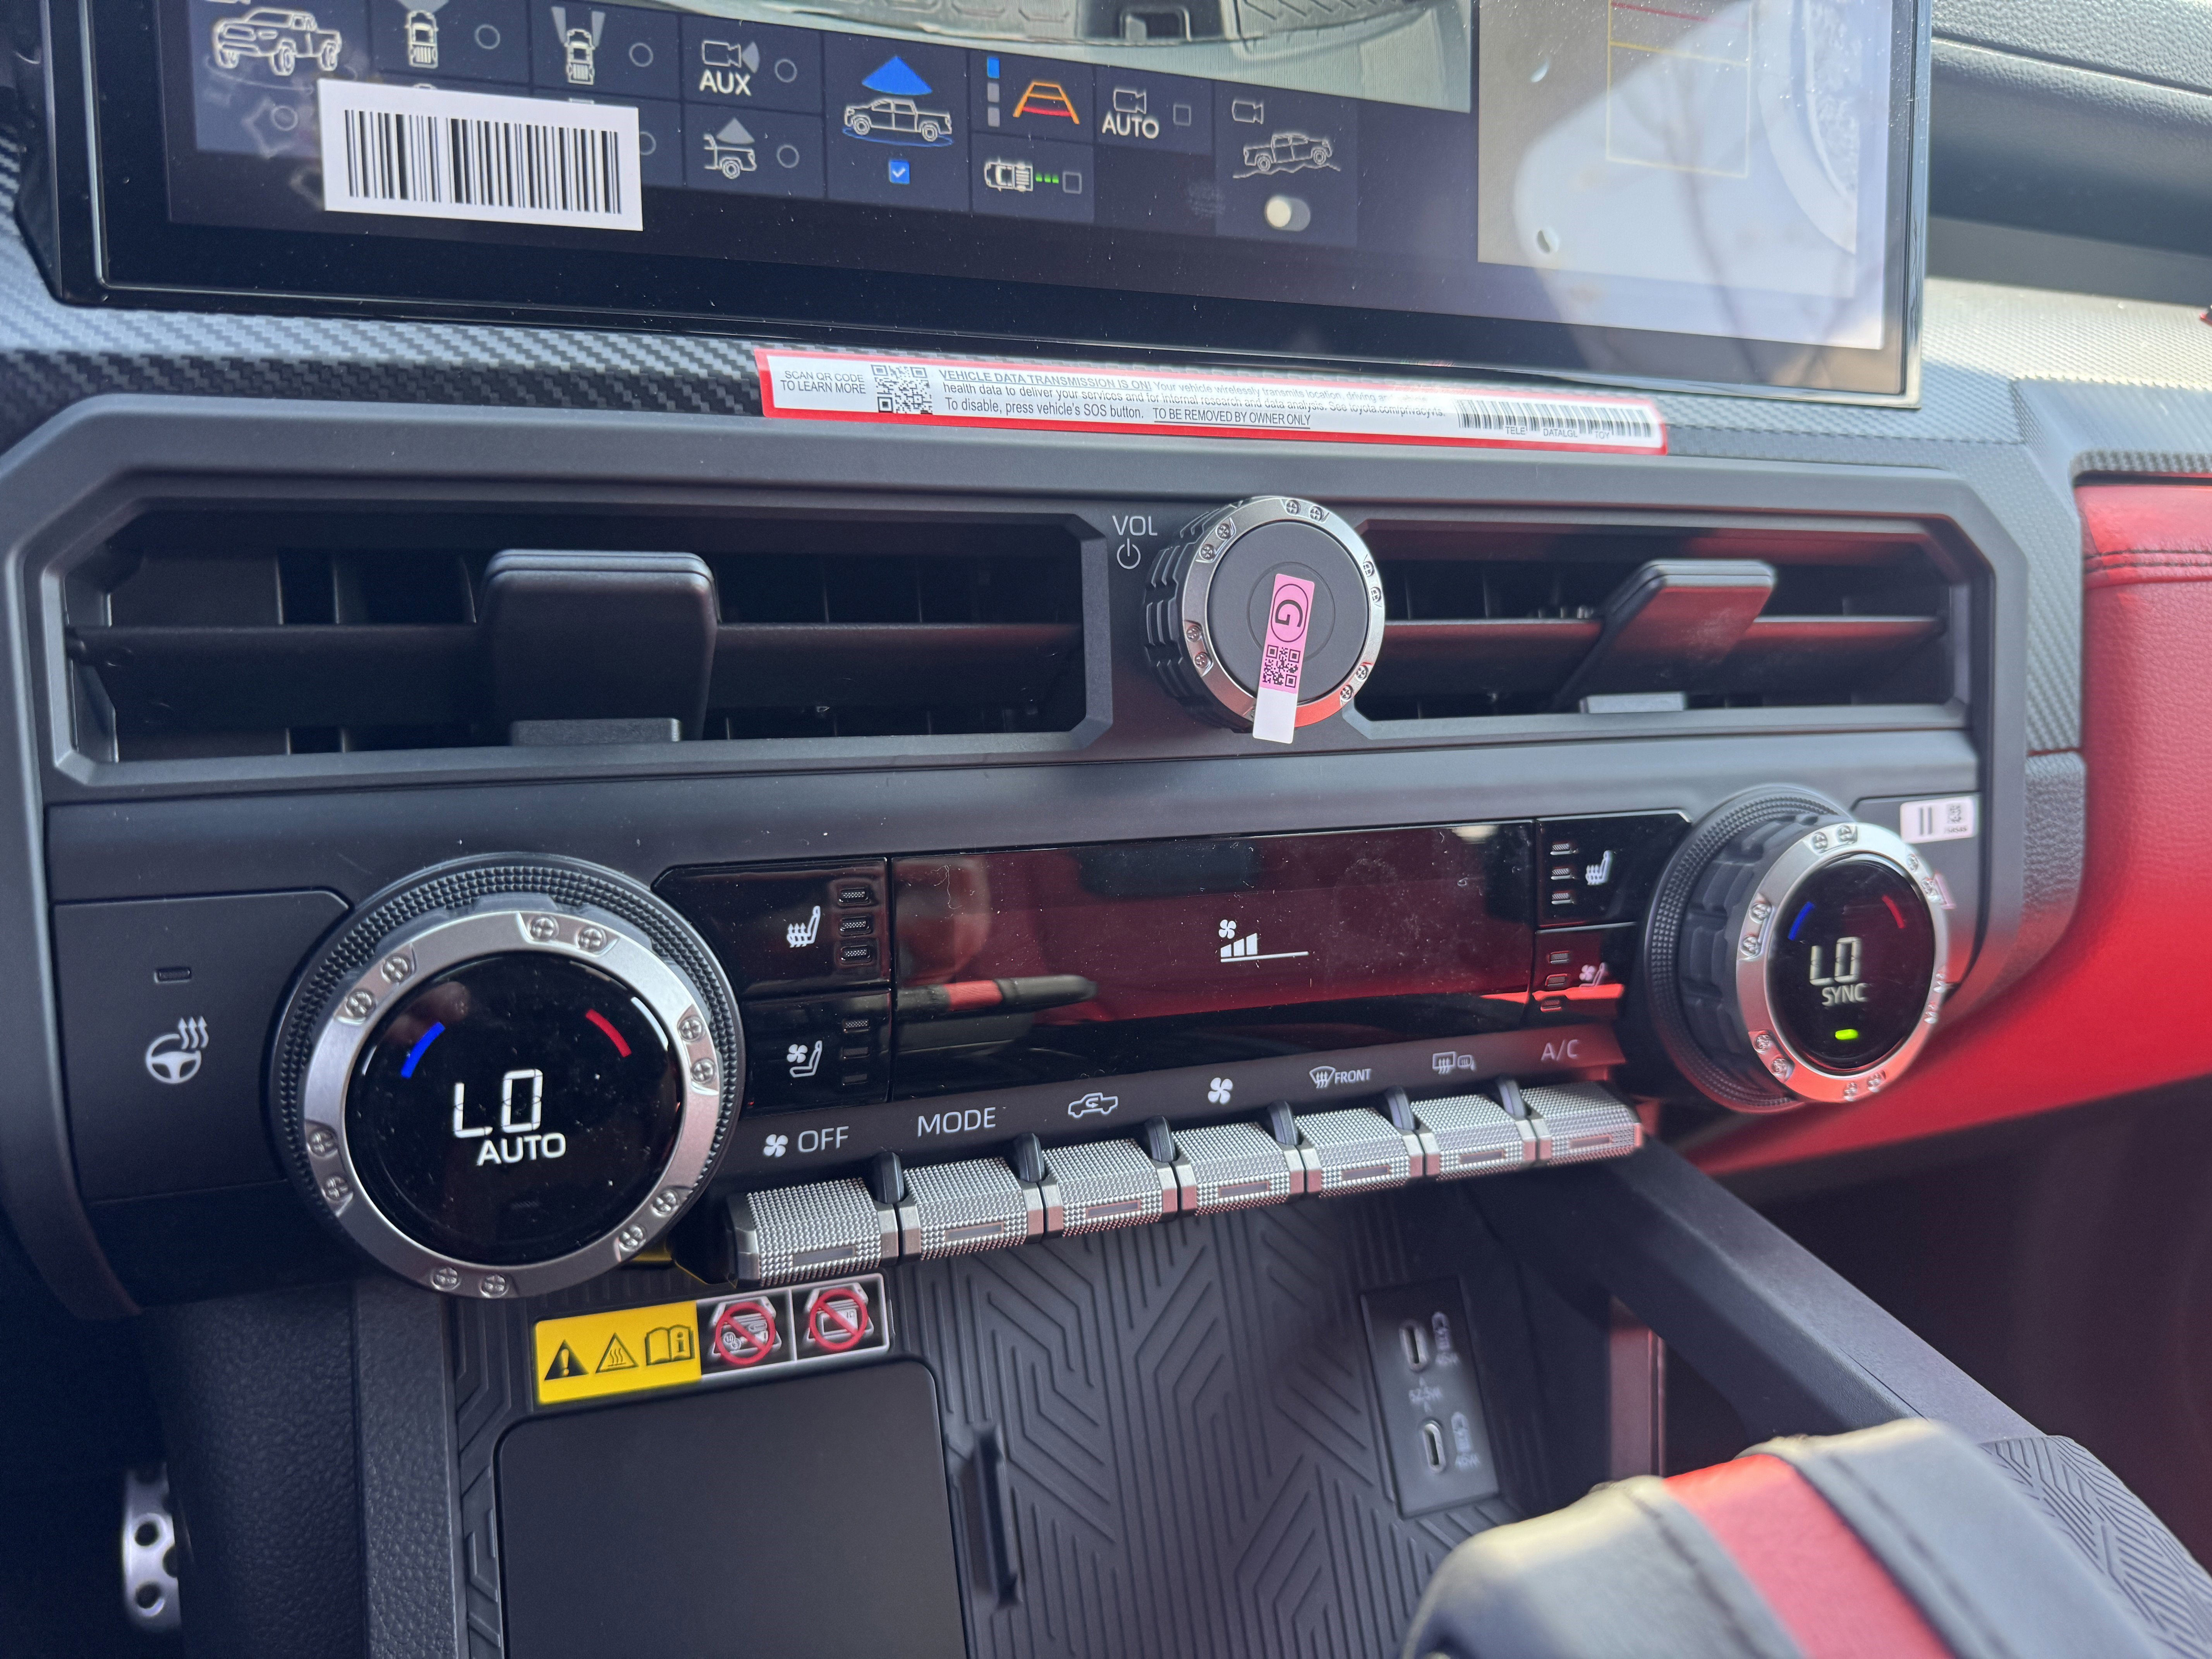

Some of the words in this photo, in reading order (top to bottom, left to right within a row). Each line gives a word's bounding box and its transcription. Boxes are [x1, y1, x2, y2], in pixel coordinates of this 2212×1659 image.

[699, 69, 751, 96] AUX
[1102, 110, 1159, 139] AUTO
[780, 380, 795, 391] TO
[798, 381, 832, 392] LEARN
[835, 383, 866, 394] MORE
[785, 371, 814, 380] SCAN
[816, 373, 832, 381] QR
[835, 373, 864, 382] CODE
[939, 370, 992, 381] VEHICLE
[994, 373, 1026, 383] DATA
[1027, 375, 1115, 388] TRANSMISSION
[1118, 380, 1128, 388] IS
[1132, 381, 1152, 390] ON!
[1153, 381, 1177, 391] Your
[1179, 384, 1212, 393] vehicle
[1214, 385, 1259, 397] wirelessly
[1262, 387, 1304, 398] transmits
[1306, 390, 1345, 400] location,
[1346, 392, 1376, 403] driving
[943, 382, 976, 394] health
[979, 384, 1002, 395] data
[1006, 386, 1015, 395] to
[1020, 386, 1053, 397] deliver
[1056, 390, 1078, 401] your
[1082, 391, 1123, 401] services
[1126, 393, 1144, 402] and
[1146, 393, 1159, 402] for
[1162, 393, 1198, 405] internal
[1201, 397, 1242, 407] research
[1245, 398, 1262, 407] and
[1265, 399, 1285, 409] data
[1288, 400, 1327, 412] analysis.
[1329, 402, 1347, 411] See
[945, 397, 958, 410] To
[962, 398, 1001, 414] disable,
[1006, 403, 1033, 416] press
[1037, 402, 1080, 416] vehicle's
[1084, 404, 1106, 416] SOS
[1111, 405, 1143, 419] button.
[1152, 408, 1166, 419] TO
[1169, 409, 1182, 419] BE
[1185, 409, 1232, 422] REMOVED
[1235, 412, 1247, 422] BY
[1249, 412, 1285, 424] OWNER
[1287, 414, 1310, 426] ONLY
[1505, 426, 1525, 435] TELE
[1112, 515, 1158, 536] VOL
[1275, 599, 1303, 627] G
[1822, 982, 1869, 1007] SYNC
[1541, 1039, 1580, 1061] A/C
[1334, 1068, 1372, 1084] FRONT
[917, 1107, 996, 1137] MODE
[476, 1132, 567, 1166] AUTO
[798, 1126, 849, 1152] OFF
